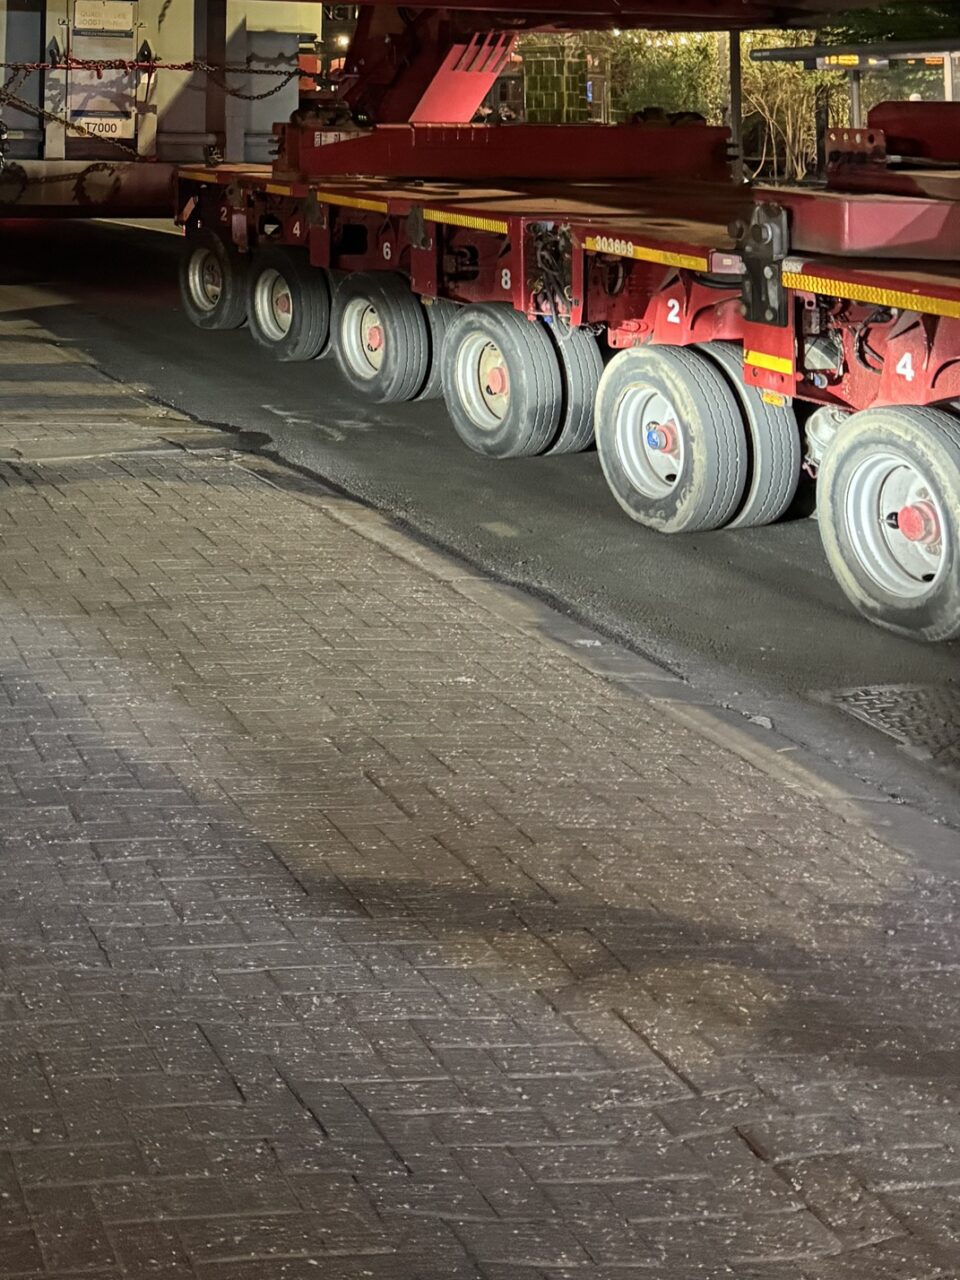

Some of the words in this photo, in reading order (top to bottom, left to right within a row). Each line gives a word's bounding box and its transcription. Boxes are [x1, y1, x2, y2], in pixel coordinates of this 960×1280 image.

[84, 121, 118, 134] T7000
[220, 206, 228, 222] 2
[292, 221, 301, 238] 4
[382, 241, 392, 260] 6
[501, 268, 512, 290] 8
[666, 298, 681, 324] 2
[895, 351, 915, 382] 4
